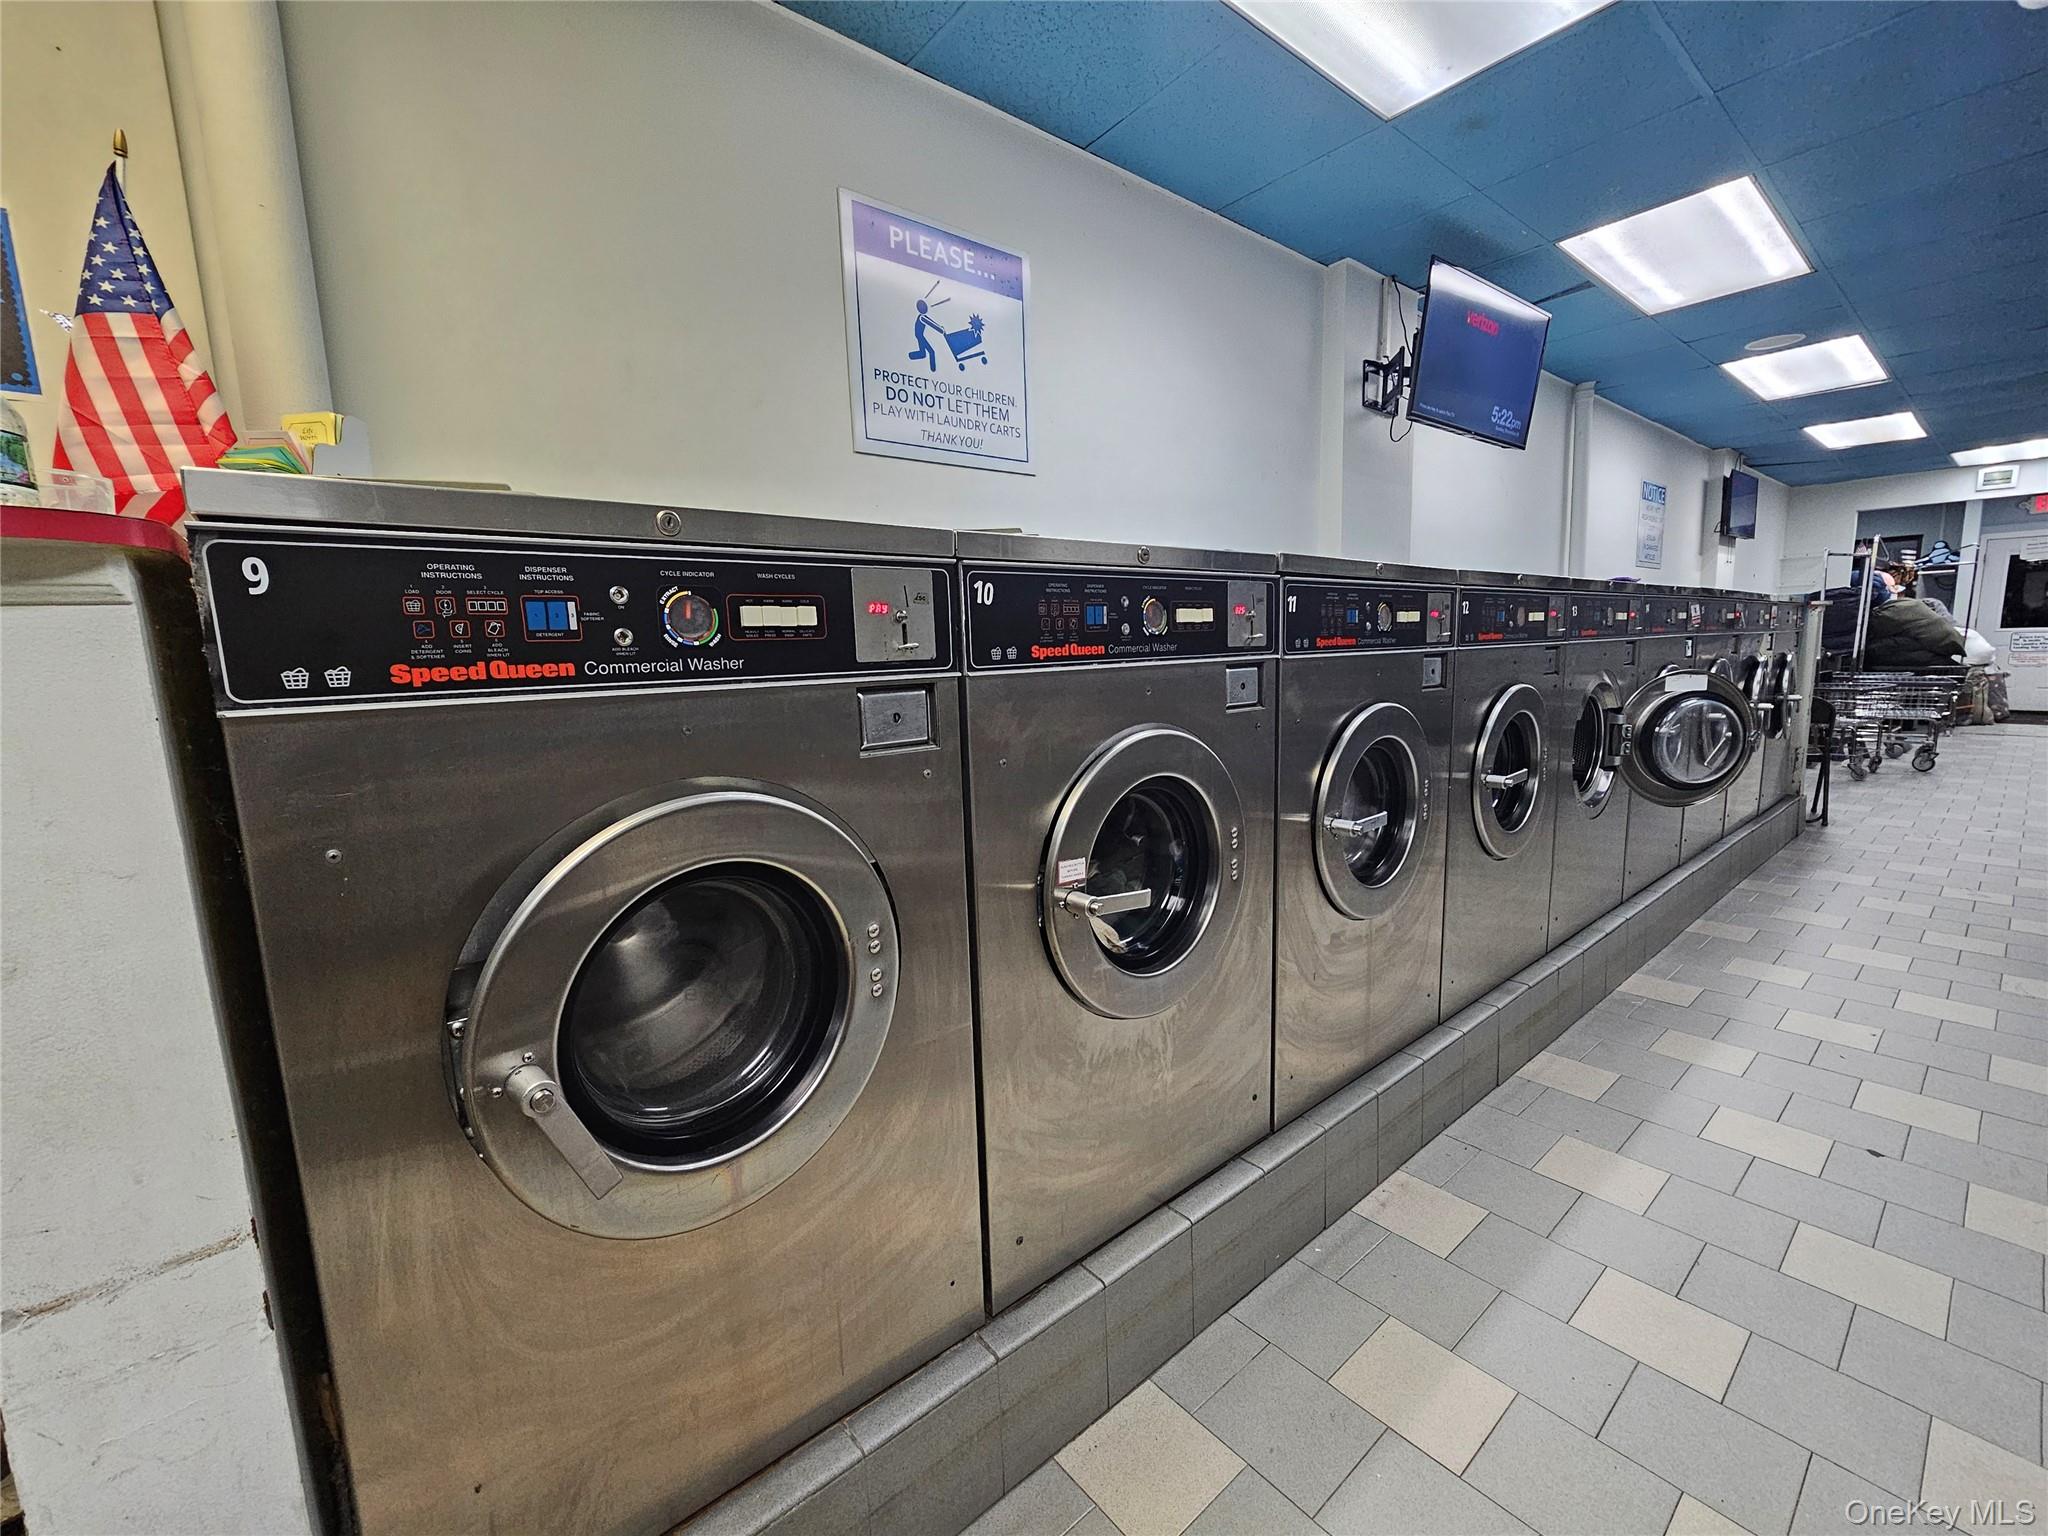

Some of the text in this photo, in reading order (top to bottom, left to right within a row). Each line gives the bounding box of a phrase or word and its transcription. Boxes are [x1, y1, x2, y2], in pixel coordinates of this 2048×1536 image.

[889, 225, 996, 280] PLEASE...
[1466, 309, 1500, 337] verizon
[874, 368, 929, 390] PROTECT
[931, 379, 963, 396] YOUR
[886, 386, 1010, 422] DO NOT LET THEM
[873, 402, 1021, 438] PLAY WITH LAUNDRY CARTS
[921, 429, 984, 450] THANK YOU!
[1643, 482, 1666, 504] NOTICE
[241, 556, 270, 595] 9
[420, 571, 483, 580] INSTRUCTIONS
[426, 563, 475, 571] OPERATING
[524, 565, 567, 574] DISPENSER
[519, 574, 575, 582] INSTRUCTIONS
[659, 586, 679, 605] EXTRACT
[973, 580, 994, 606] 10
[1287, 595, 1297, 613] 11
[1462, 601, 1470, 615] 12
[1031, 642, 1178, 659] Speed Queen Commercial Washer
[389, 657, 744, 688] Speed Queen Commercial Washer
